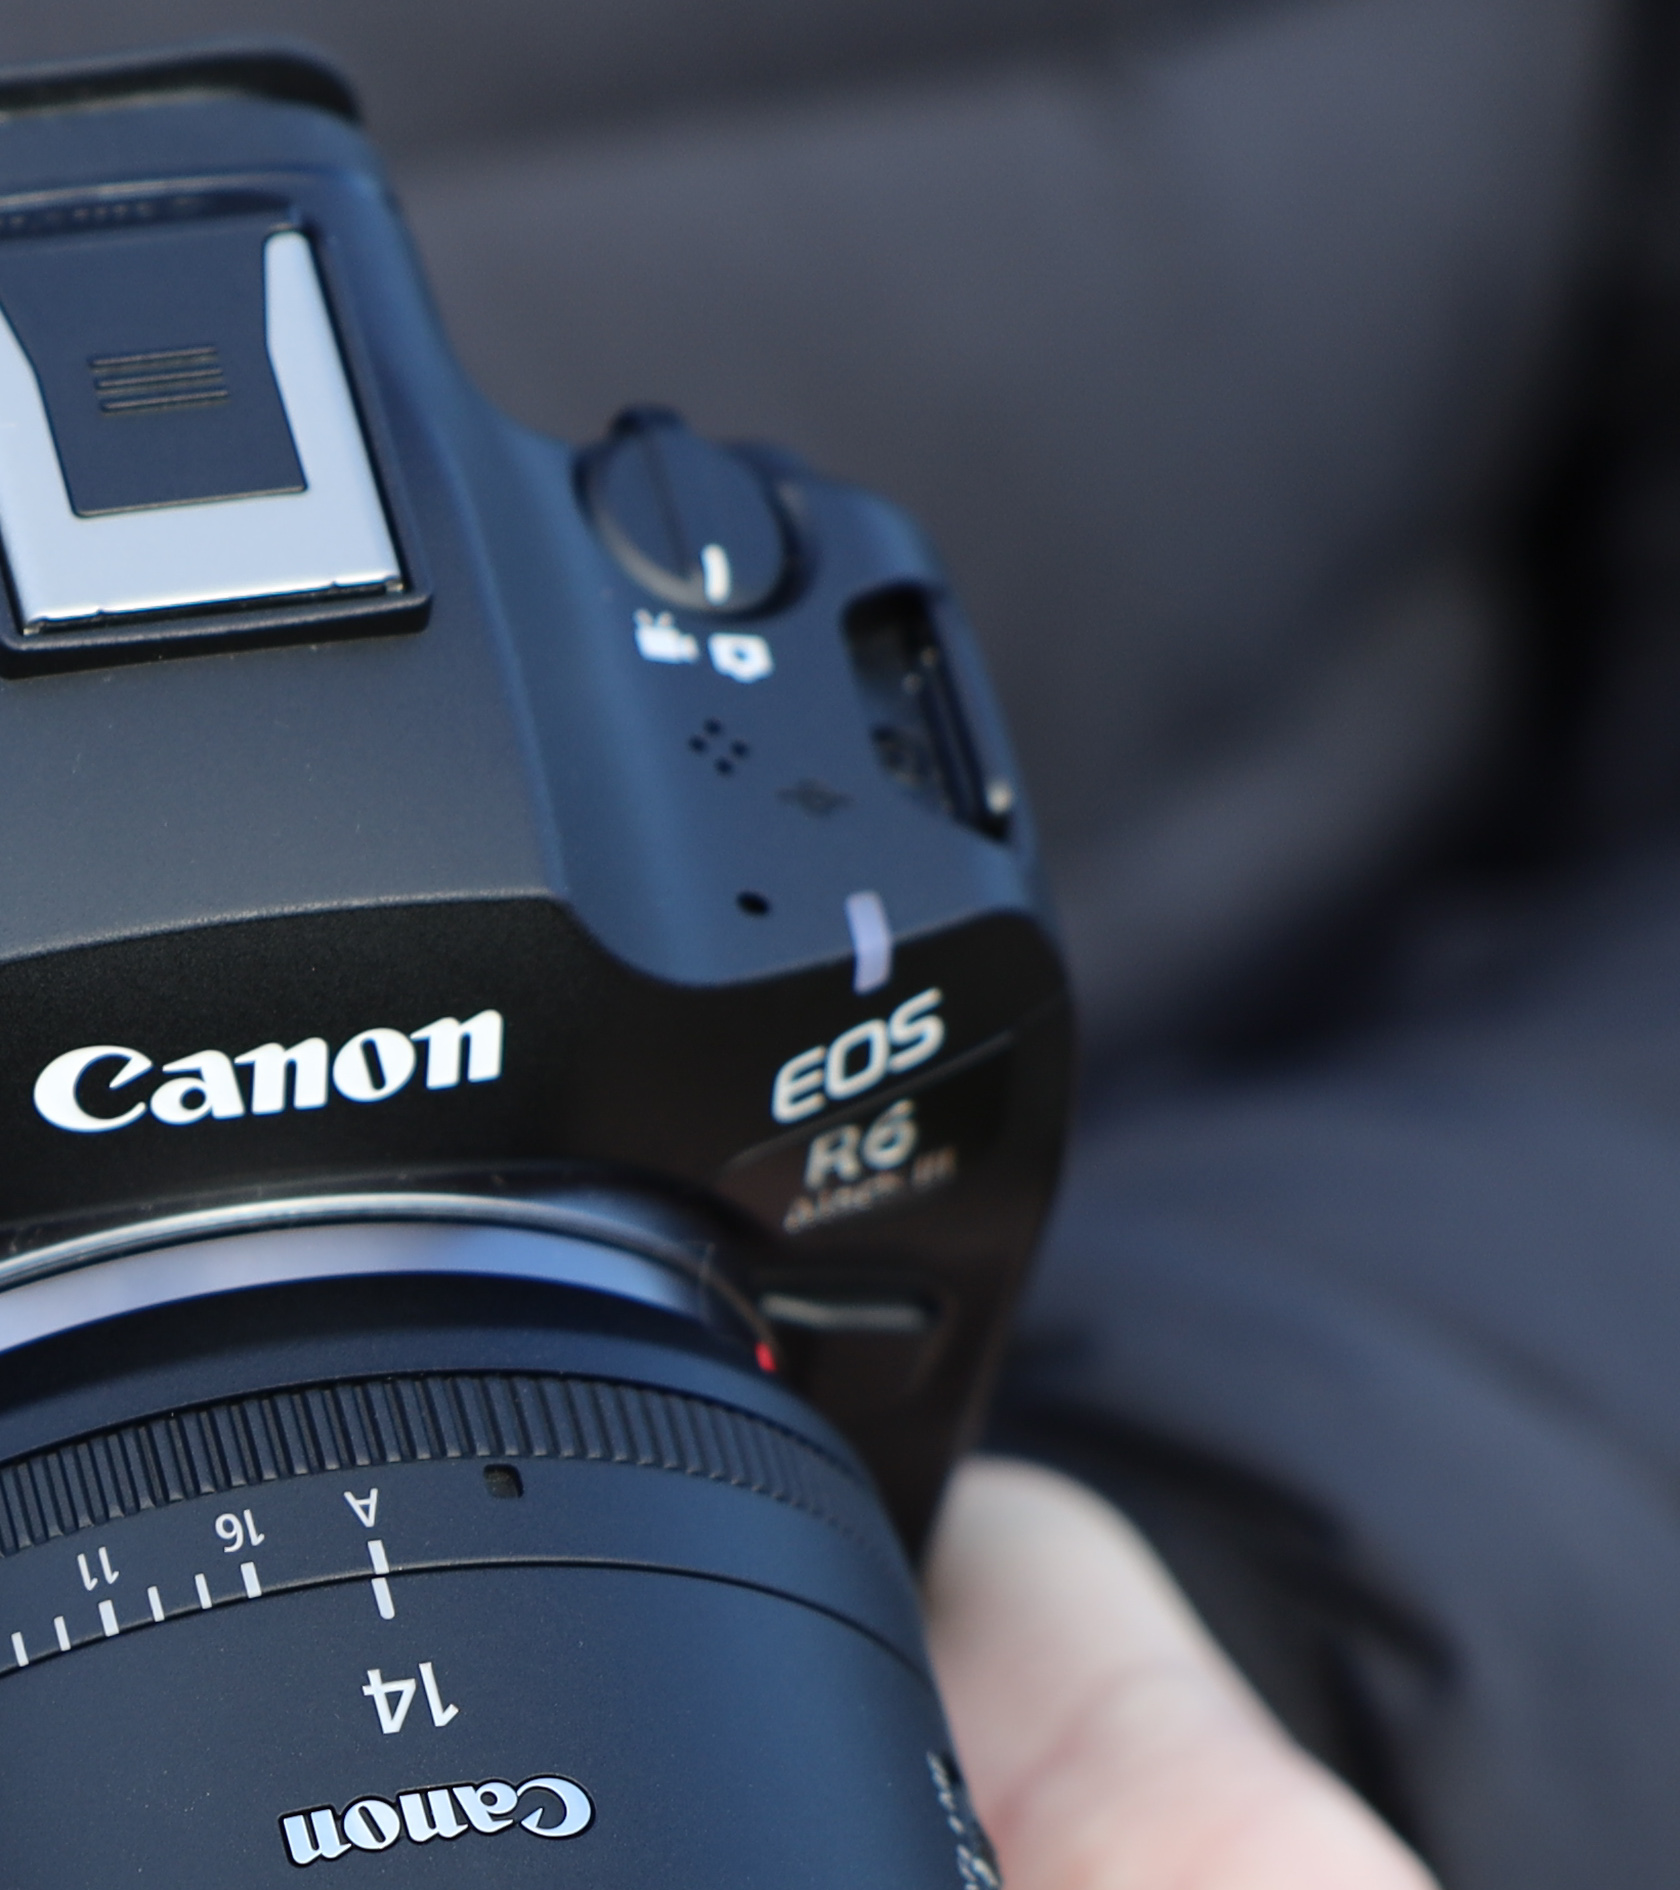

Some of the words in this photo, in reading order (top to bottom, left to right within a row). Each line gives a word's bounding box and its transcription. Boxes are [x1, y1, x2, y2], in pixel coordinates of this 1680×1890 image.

[34, 1010, 502, 1130] Canon
[772, 987, 944, 1123] EOS
[805, 1099, 916, 1188] R6
[216, 1510, 264, 1552] 16
[344, 1489, 378, 1527] A
[78, 1547, 119, 1590] 11
[363, 1662, 458, 1733] 14
[283, 1778, 591, 1865] Canon
